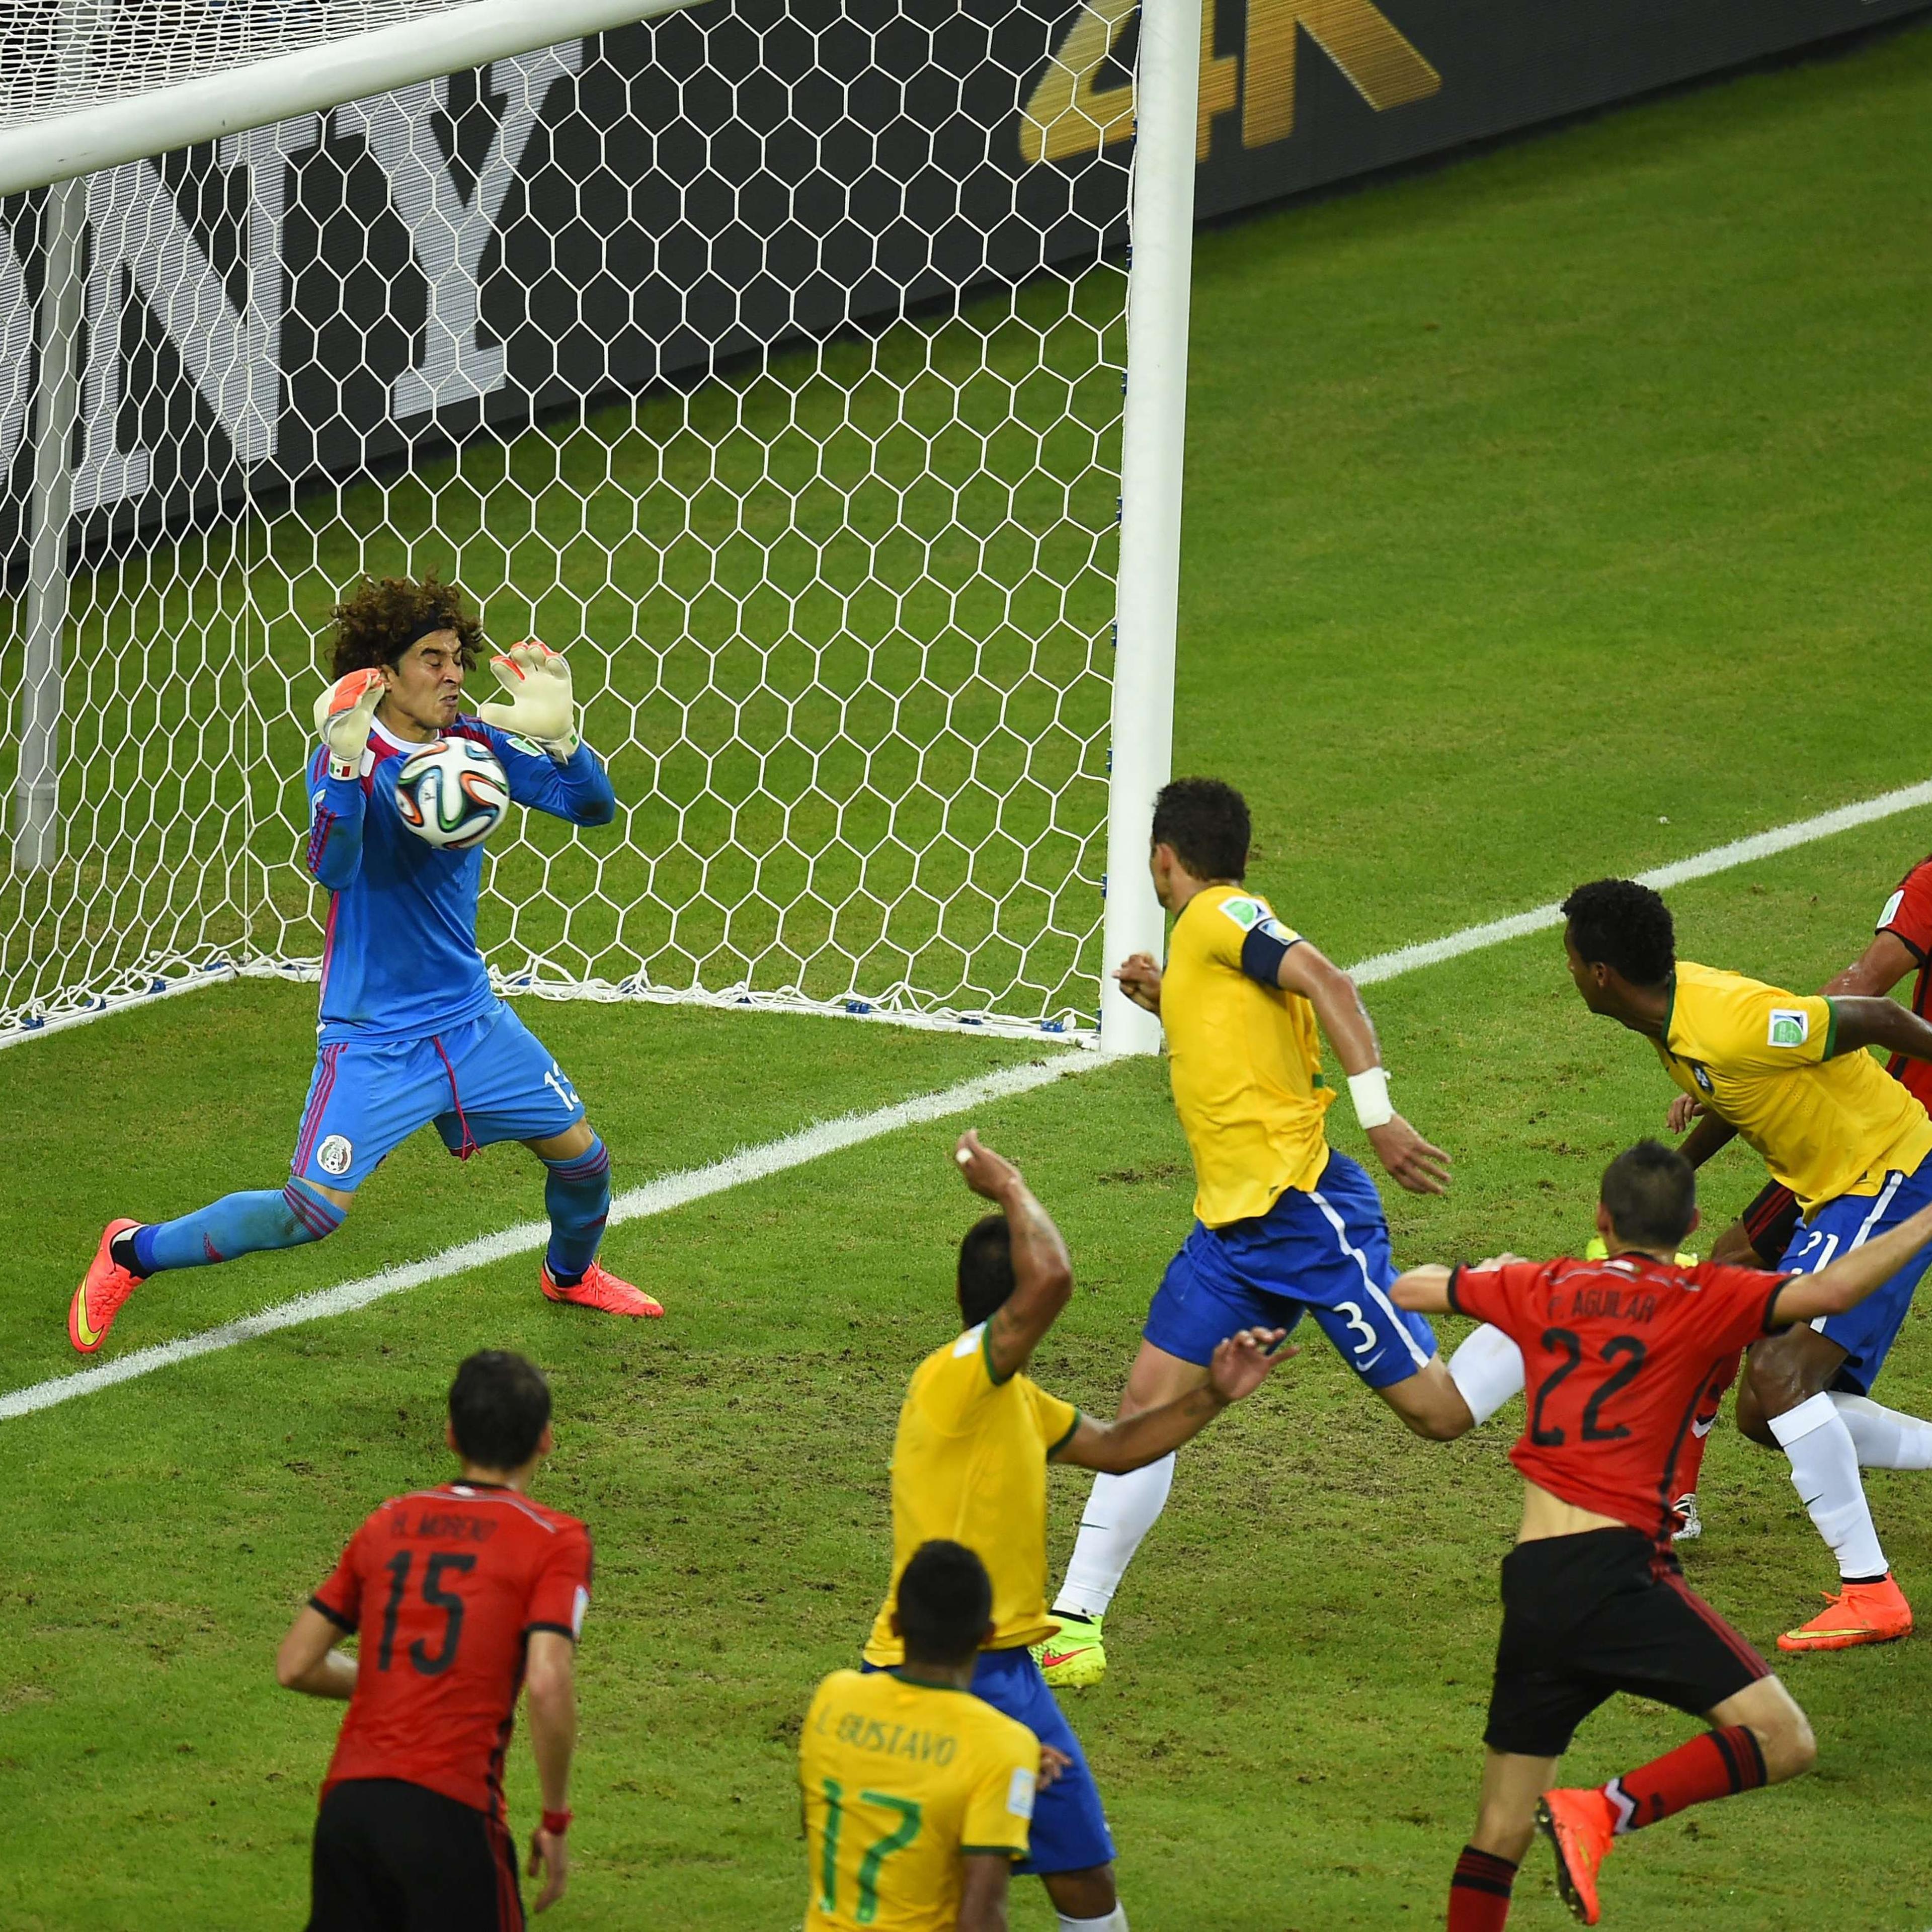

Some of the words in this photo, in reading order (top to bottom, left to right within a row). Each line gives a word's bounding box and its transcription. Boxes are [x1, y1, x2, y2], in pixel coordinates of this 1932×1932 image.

[0, 37, 584, 512] NY
[1333, 1301, 1377, 1354] 3
[1572, 1289, 1657, 1323] AGUILAR
[1531, 1327, 1647, 1446] 22
[378, 1550, 477, 1676] 15
[836, 1712, 957, 1767] GUSTAVO
[819, 1778, 922, 1923] 17
